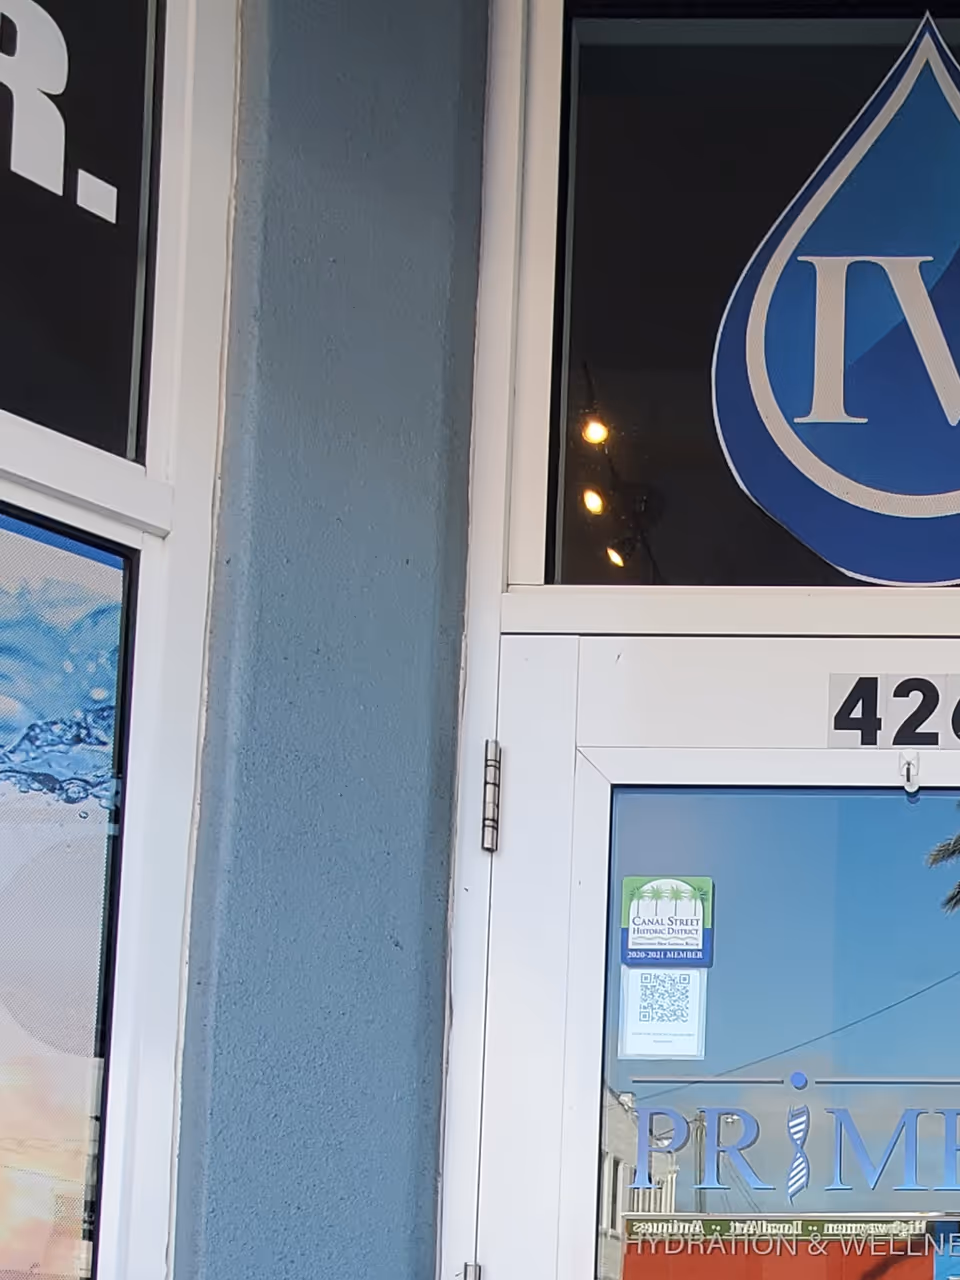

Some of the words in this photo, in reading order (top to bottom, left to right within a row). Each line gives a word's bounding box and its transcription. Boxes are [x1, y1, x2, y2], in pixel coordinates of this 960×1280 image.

[632, 916, 665, 927] CANAL
[667, 916, 701, 927] STREET
[667, 927, 699, 936] DISTRICT
[666, 950, 703, 959] MEMBER
[625, 1233, 798, 1256] HYDRATION
[807, 1232, 835, 1256] &
